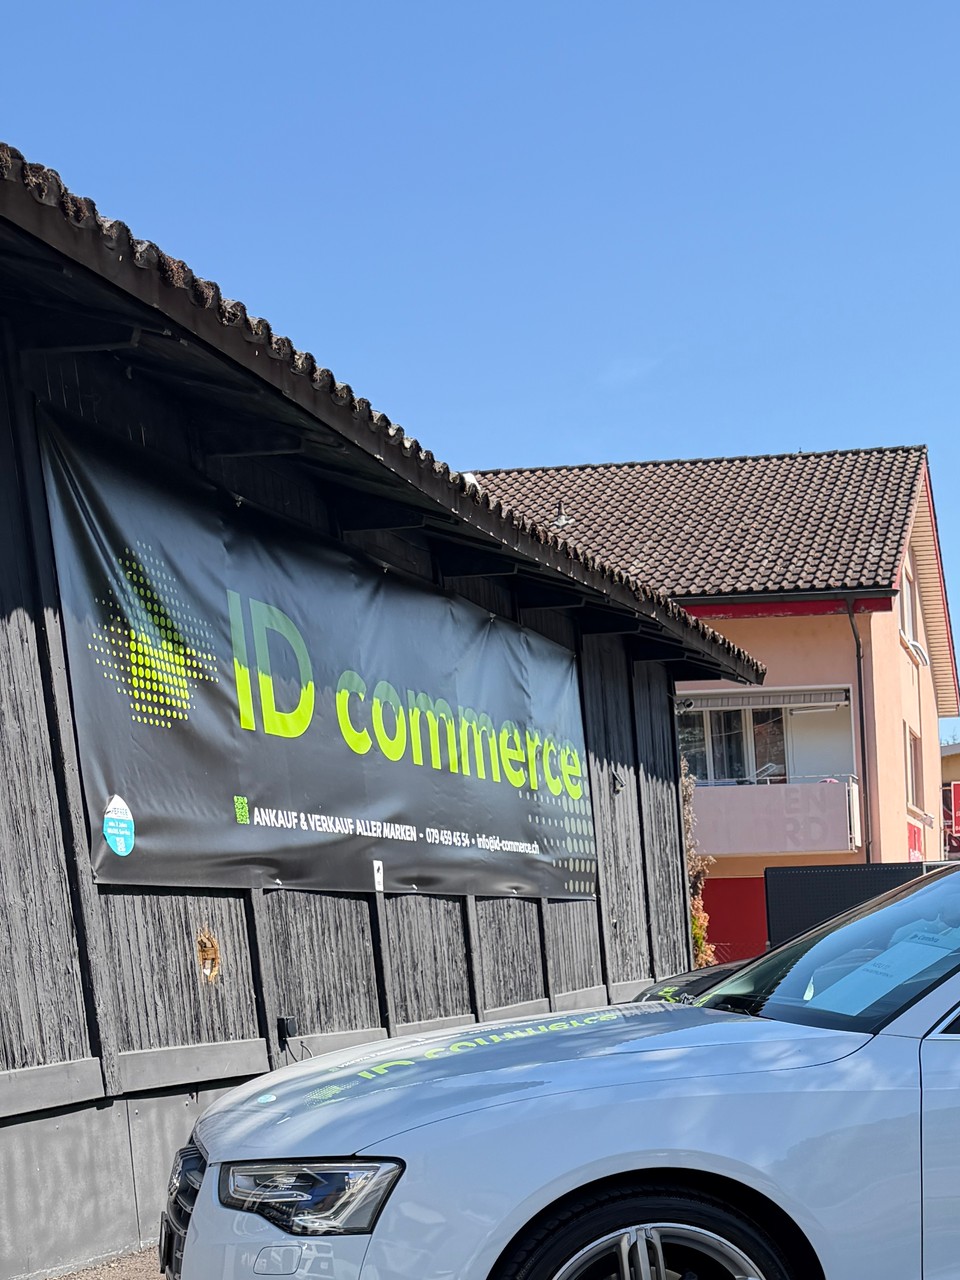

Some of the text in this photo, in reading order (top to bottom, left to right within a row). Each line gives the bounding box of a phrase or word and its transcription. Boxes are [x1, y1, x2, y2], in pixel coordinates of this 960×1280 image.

[226, 589, 584, 801] ID commerce
[253, 806, 540, 855] ANKAUF & VERKAUF ALLER MARKEN 079 459 45 54 info@id-commerce.ch
